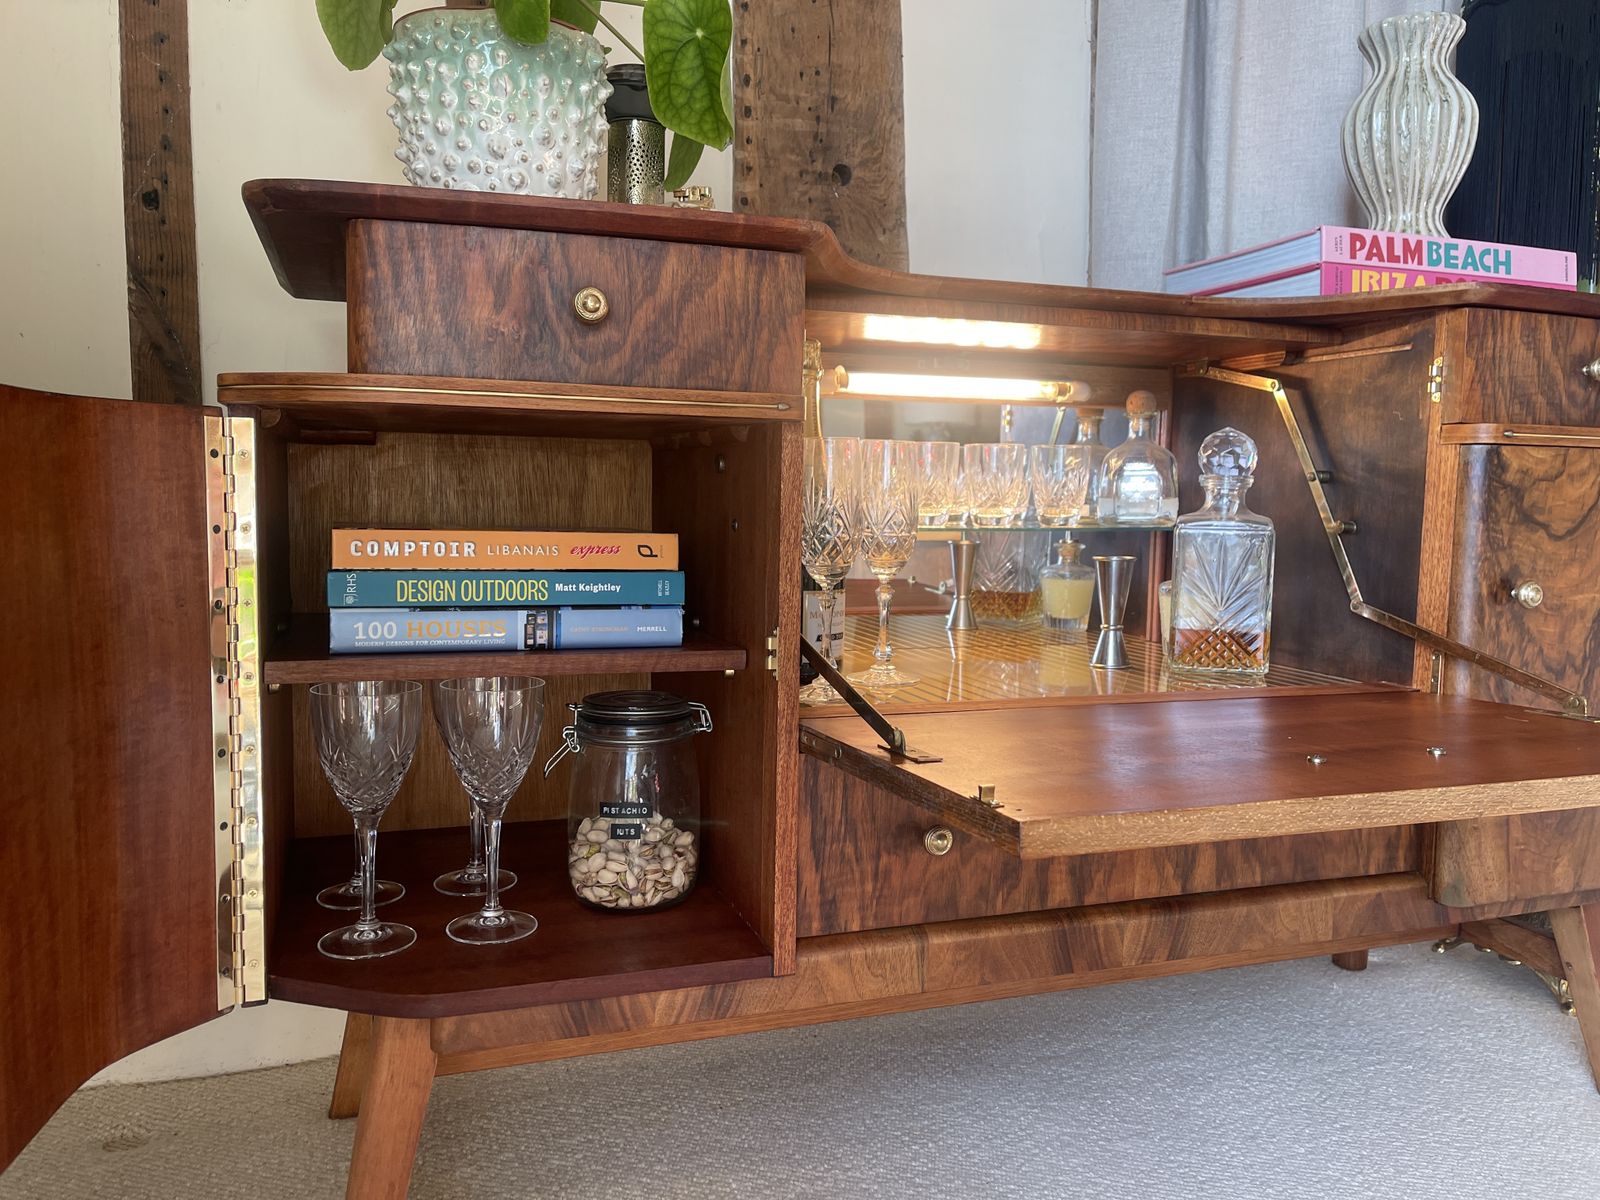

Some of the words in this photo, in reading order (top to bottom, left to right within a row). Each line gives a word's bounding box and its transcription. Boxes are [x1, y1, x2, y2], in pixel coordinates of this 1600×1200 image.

[1350, 233, 1423, 266] PALM
[1427, 240, 1512, 275] BEACH
[350, 540, 476, 557] COMPTOIR
[487, 545, 559, 556] LIBANAIS
[570, 545, 622, 560] express
[346, 573, 357, 593] RHS
[396, 579, 456, 602] DESIGN
[461, 579, 549, 601] OUTDOORS
[555, 583, 577, 592] Matt
[578, 582, 621, 593] Keightley
[353, 621, 397, 640] 100
[406, 619, 508, 639] HOUSES
[602, 806, 648, 815] PISTACHIO
[616, 828, 636, 836] NUTS
